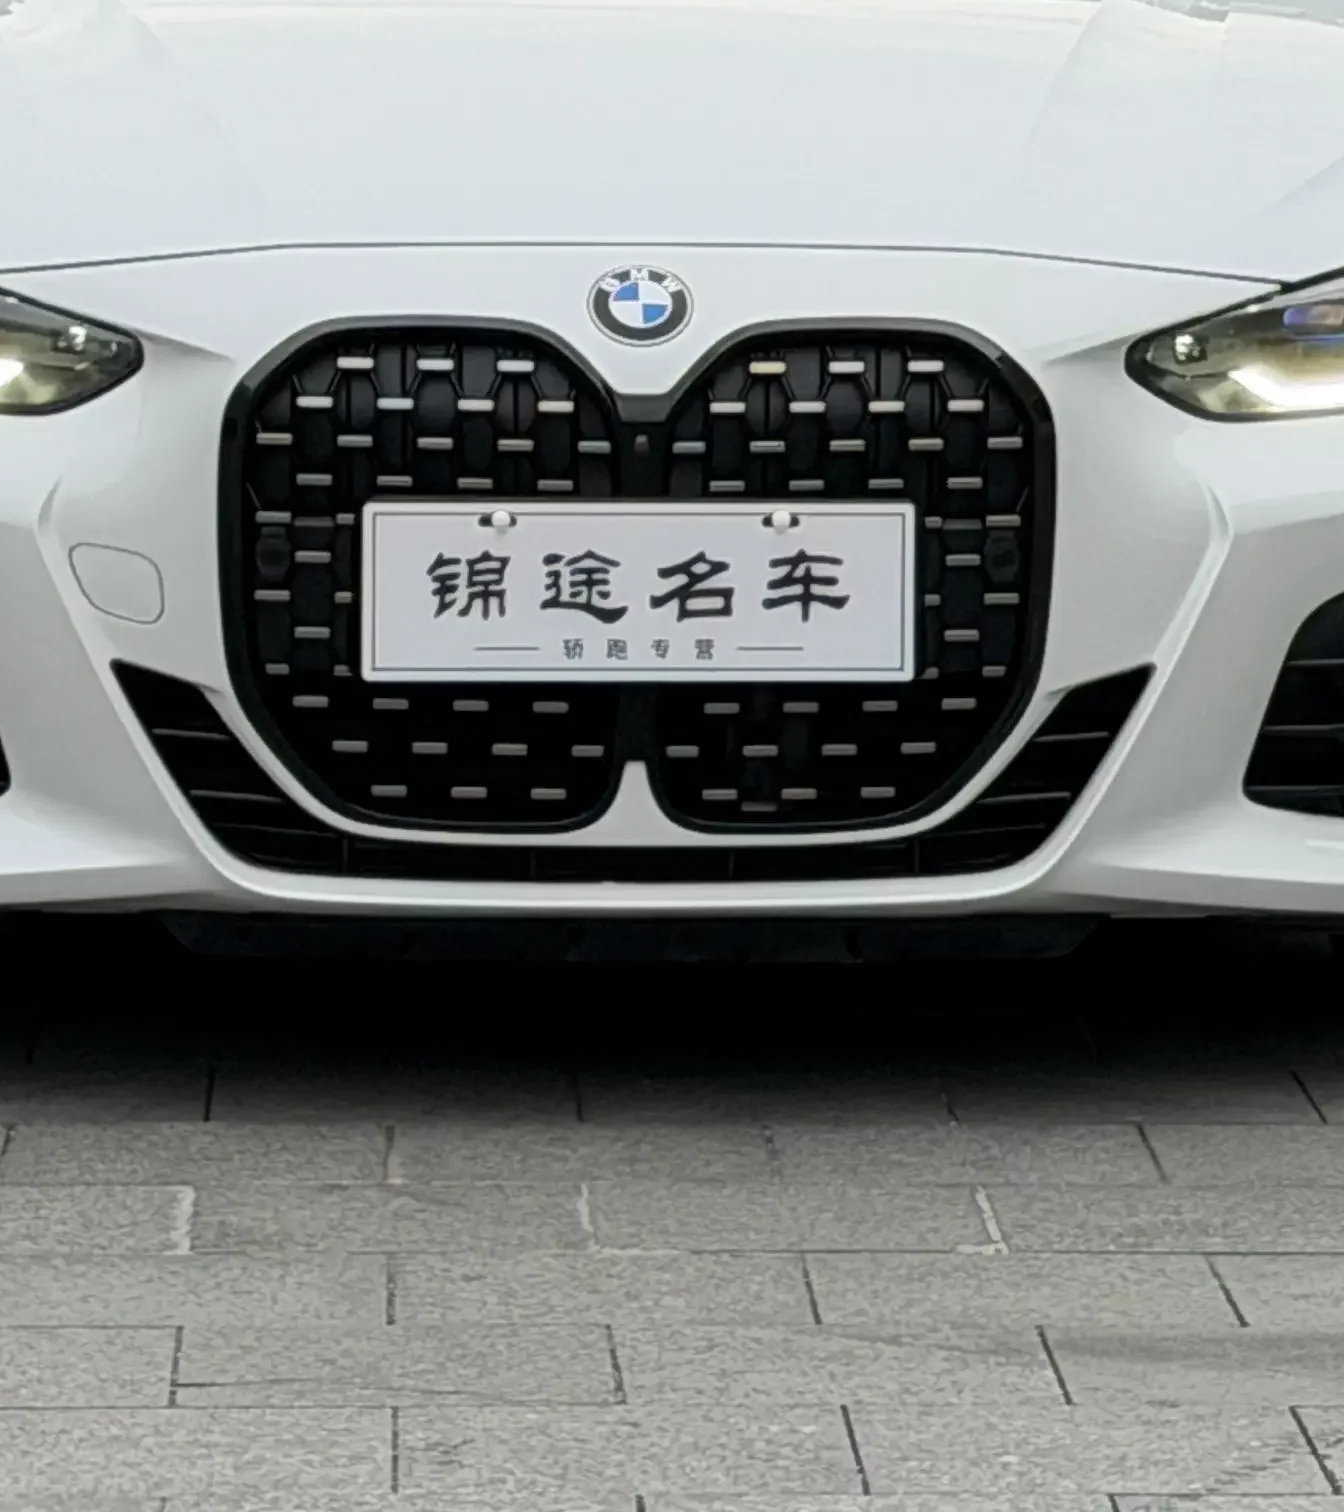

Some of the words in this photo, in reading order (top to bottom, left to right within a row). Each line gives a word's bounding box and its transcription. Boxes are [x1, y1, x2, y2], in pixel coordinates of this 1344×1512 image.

[598, 268, 683, 293] BMW
[425, 549, 851, 624] 锦途名车
[562, 638, 716, 661] 轿跑专营
